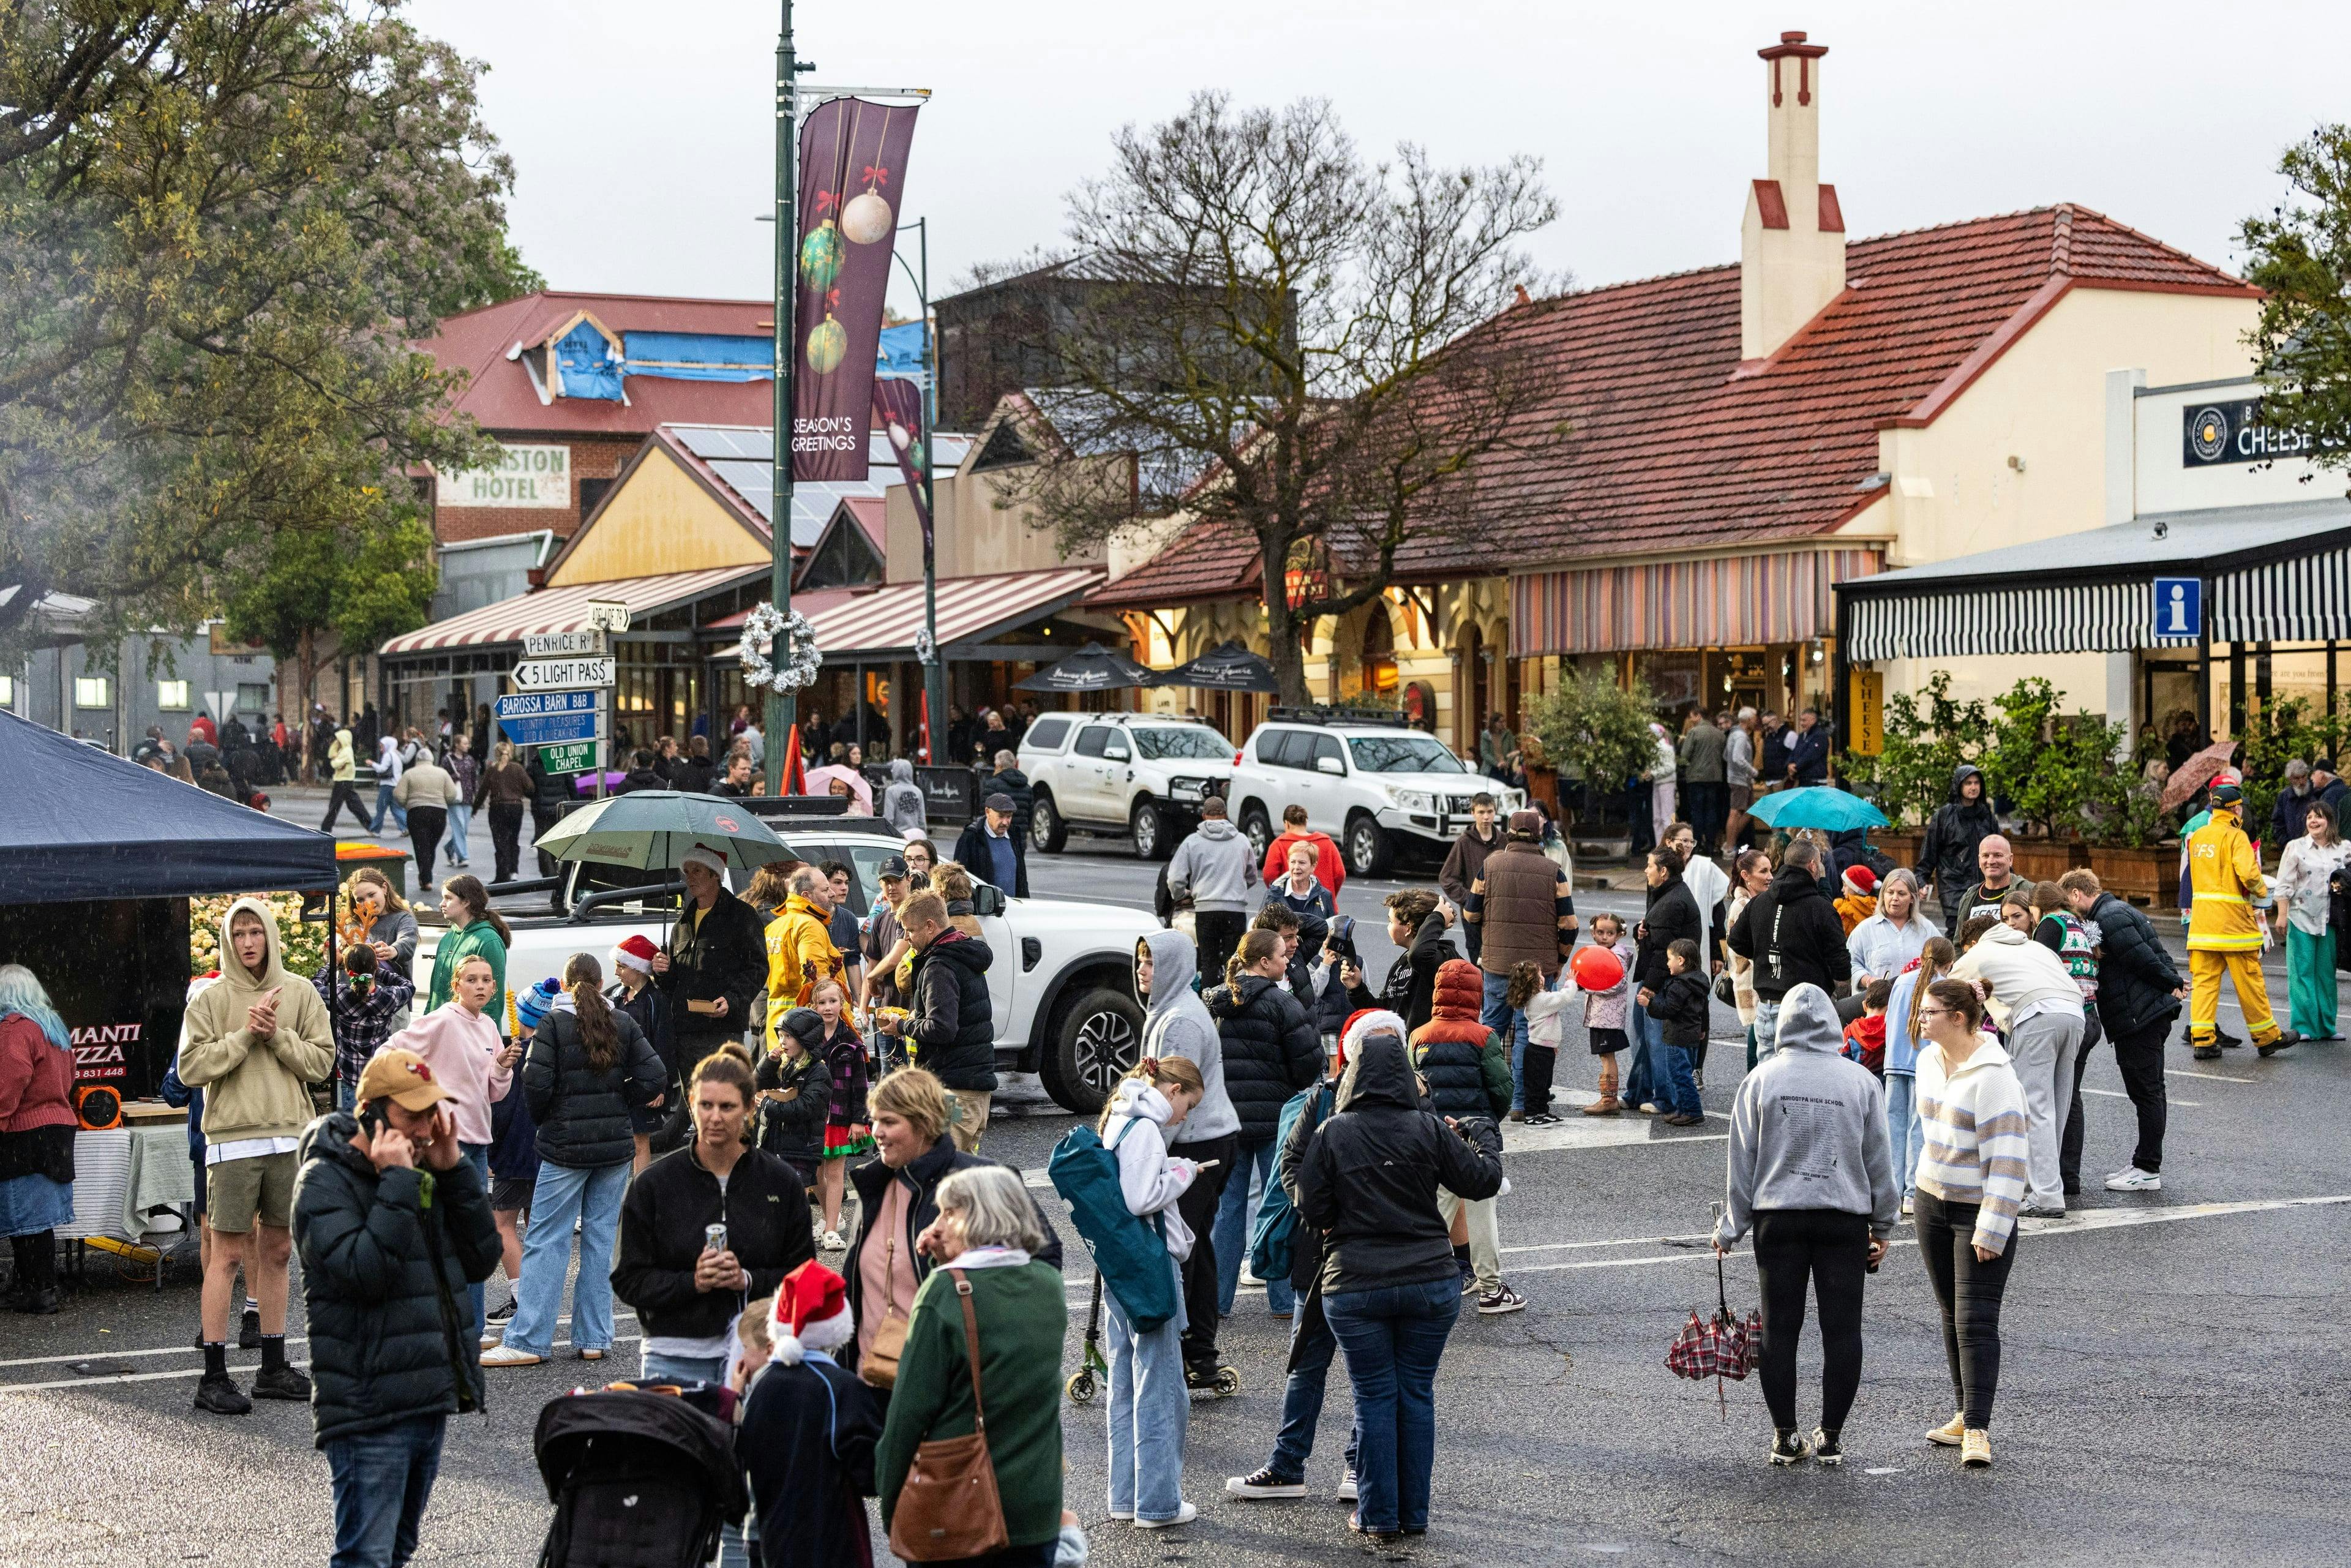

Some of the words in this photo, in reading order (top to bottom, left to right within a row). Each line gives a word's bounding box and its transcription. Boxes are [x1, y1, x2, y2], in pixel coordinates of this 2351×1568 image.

[793, 417, 852, 433] SEASON'S
[791, 435, 855, 452] GREETINGS
[495, 449, 564, 471] ASTON
[473, 477, 538, 500] HOTEL
[529, 634, 574, 653] PENRICE
[533, 666, 539, 684] 5
[543, 664, 574, 683] LIGHT
[579, 662, 606, 681] PASS
[502, 696, 541, 715] BAROSSA
[545, 694, 567, 711] BARN
[572, 694, 587, 708] B&B
[1862, 676, 1872, 751] CHEESE
[517, 718, 547, 730] COUNTRY
[549, 715, 586, 728] PLEASURES
[545, 727, 580, 740] BREAKFAST
[550, 748, 564, 759] OLD
[568, 744, 588, 757] UNION
[556, 757, 583, 770] CHAPEL
[70, 1024, 141, 1044] MANTI
[74, 1045, 125, 1063] ZZA
